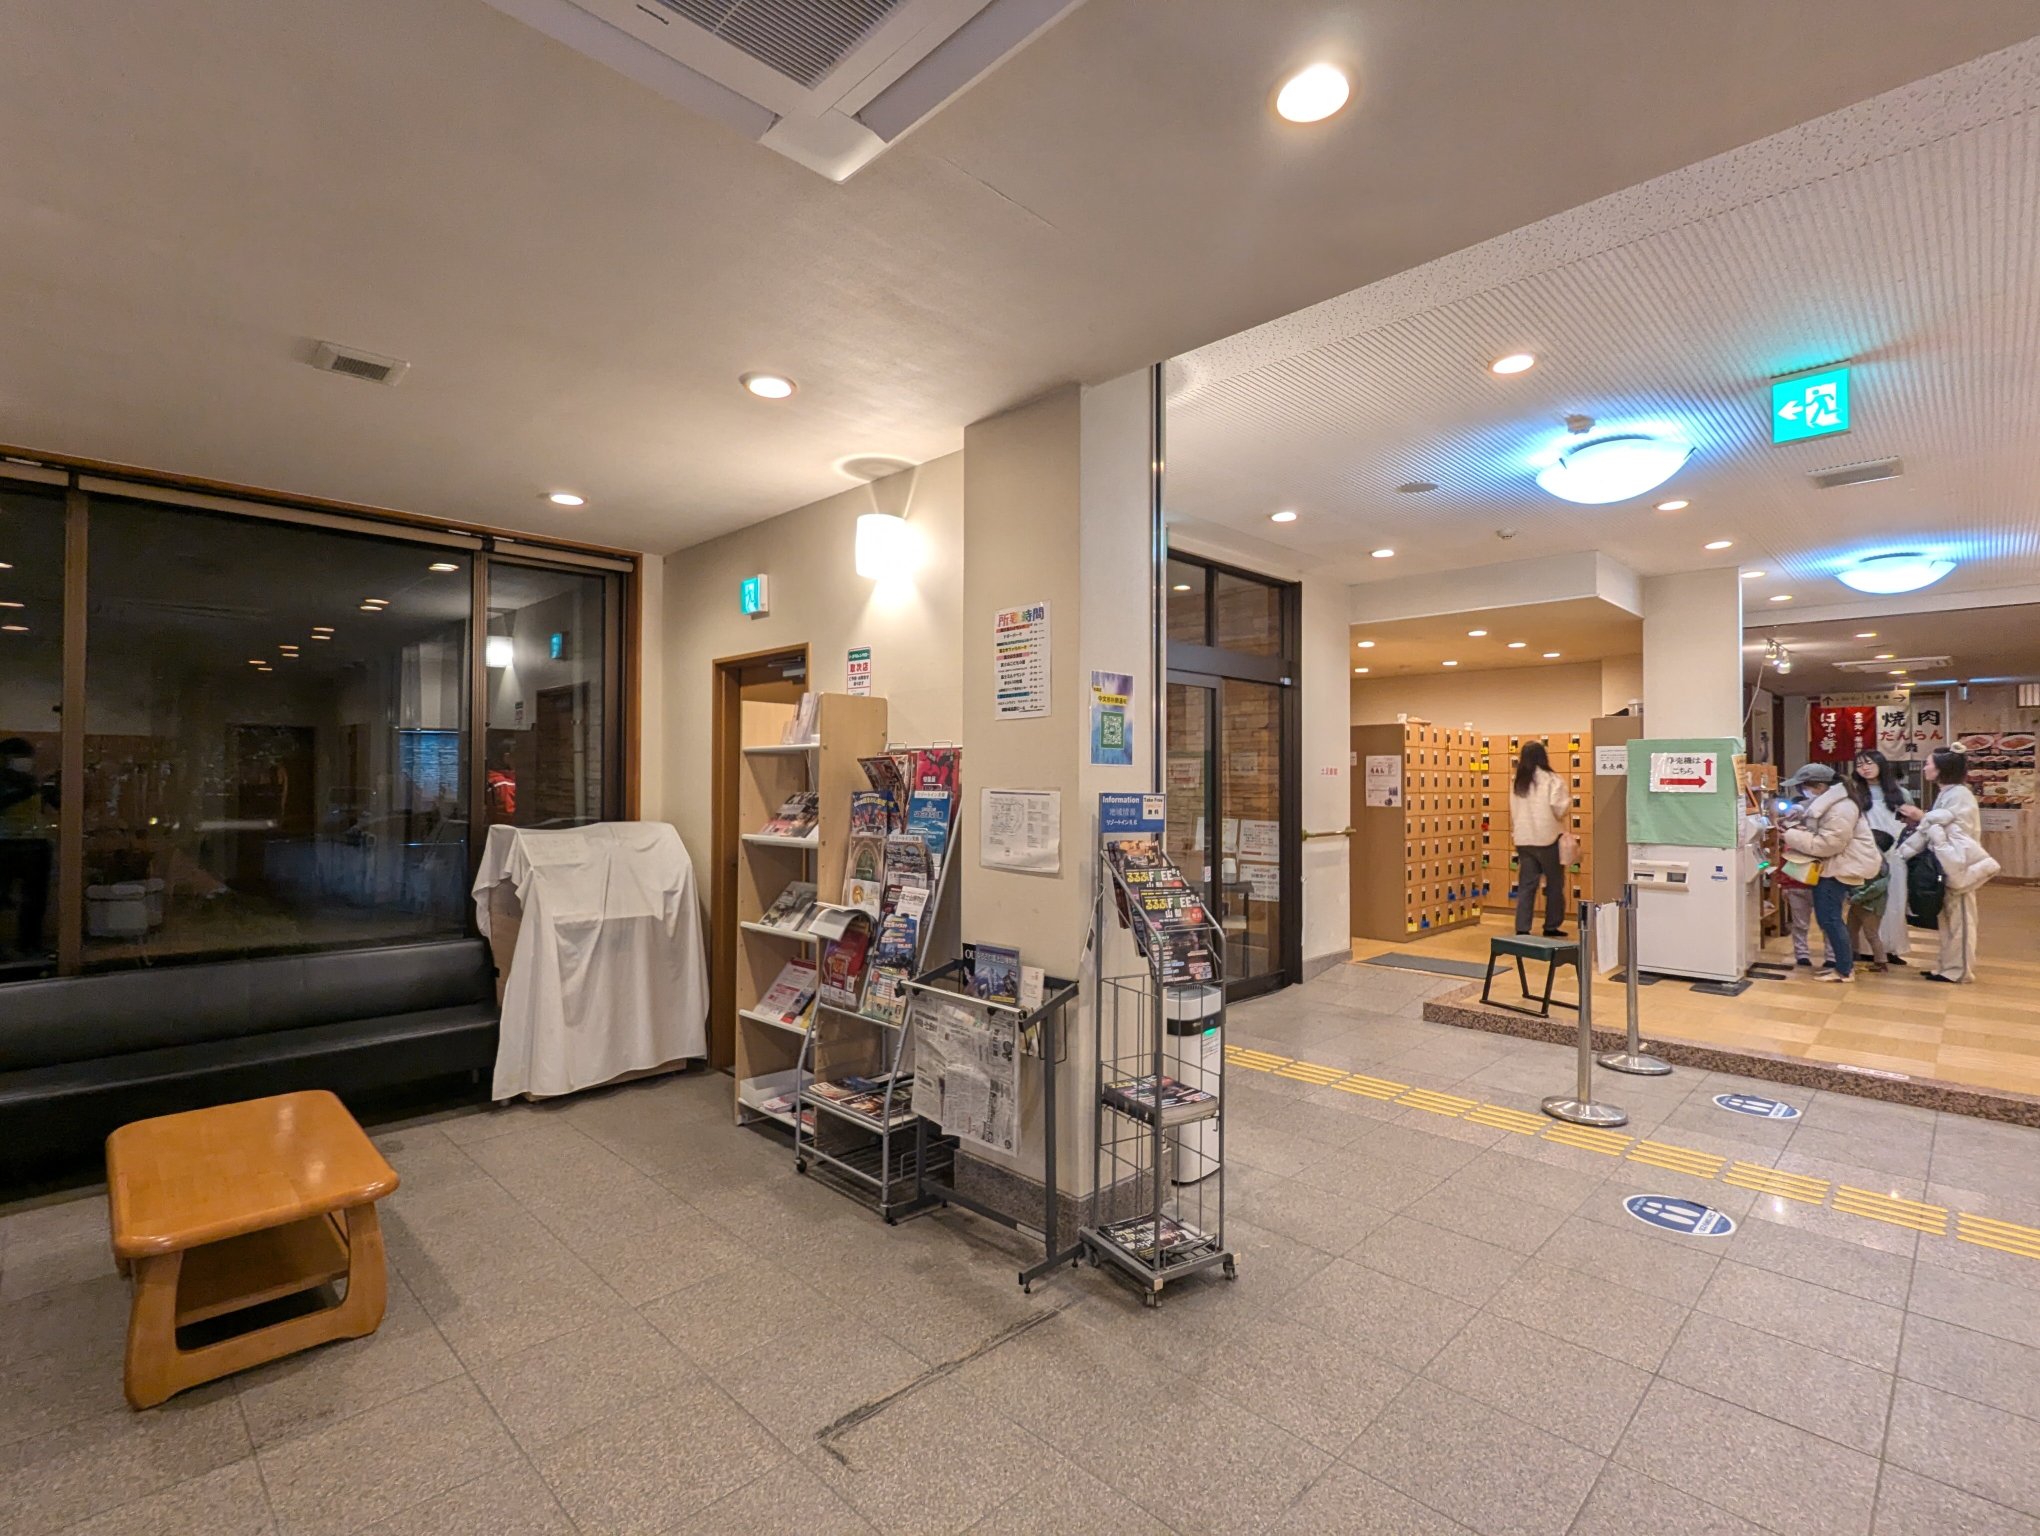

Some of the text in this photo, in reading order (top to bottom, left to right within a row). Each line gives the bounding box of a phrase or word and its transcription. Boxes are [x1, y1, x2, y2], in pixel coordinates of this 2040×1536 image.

[1880, 730, 1943, 741] だんらん
[1103, 796, 1139, 804] Information
